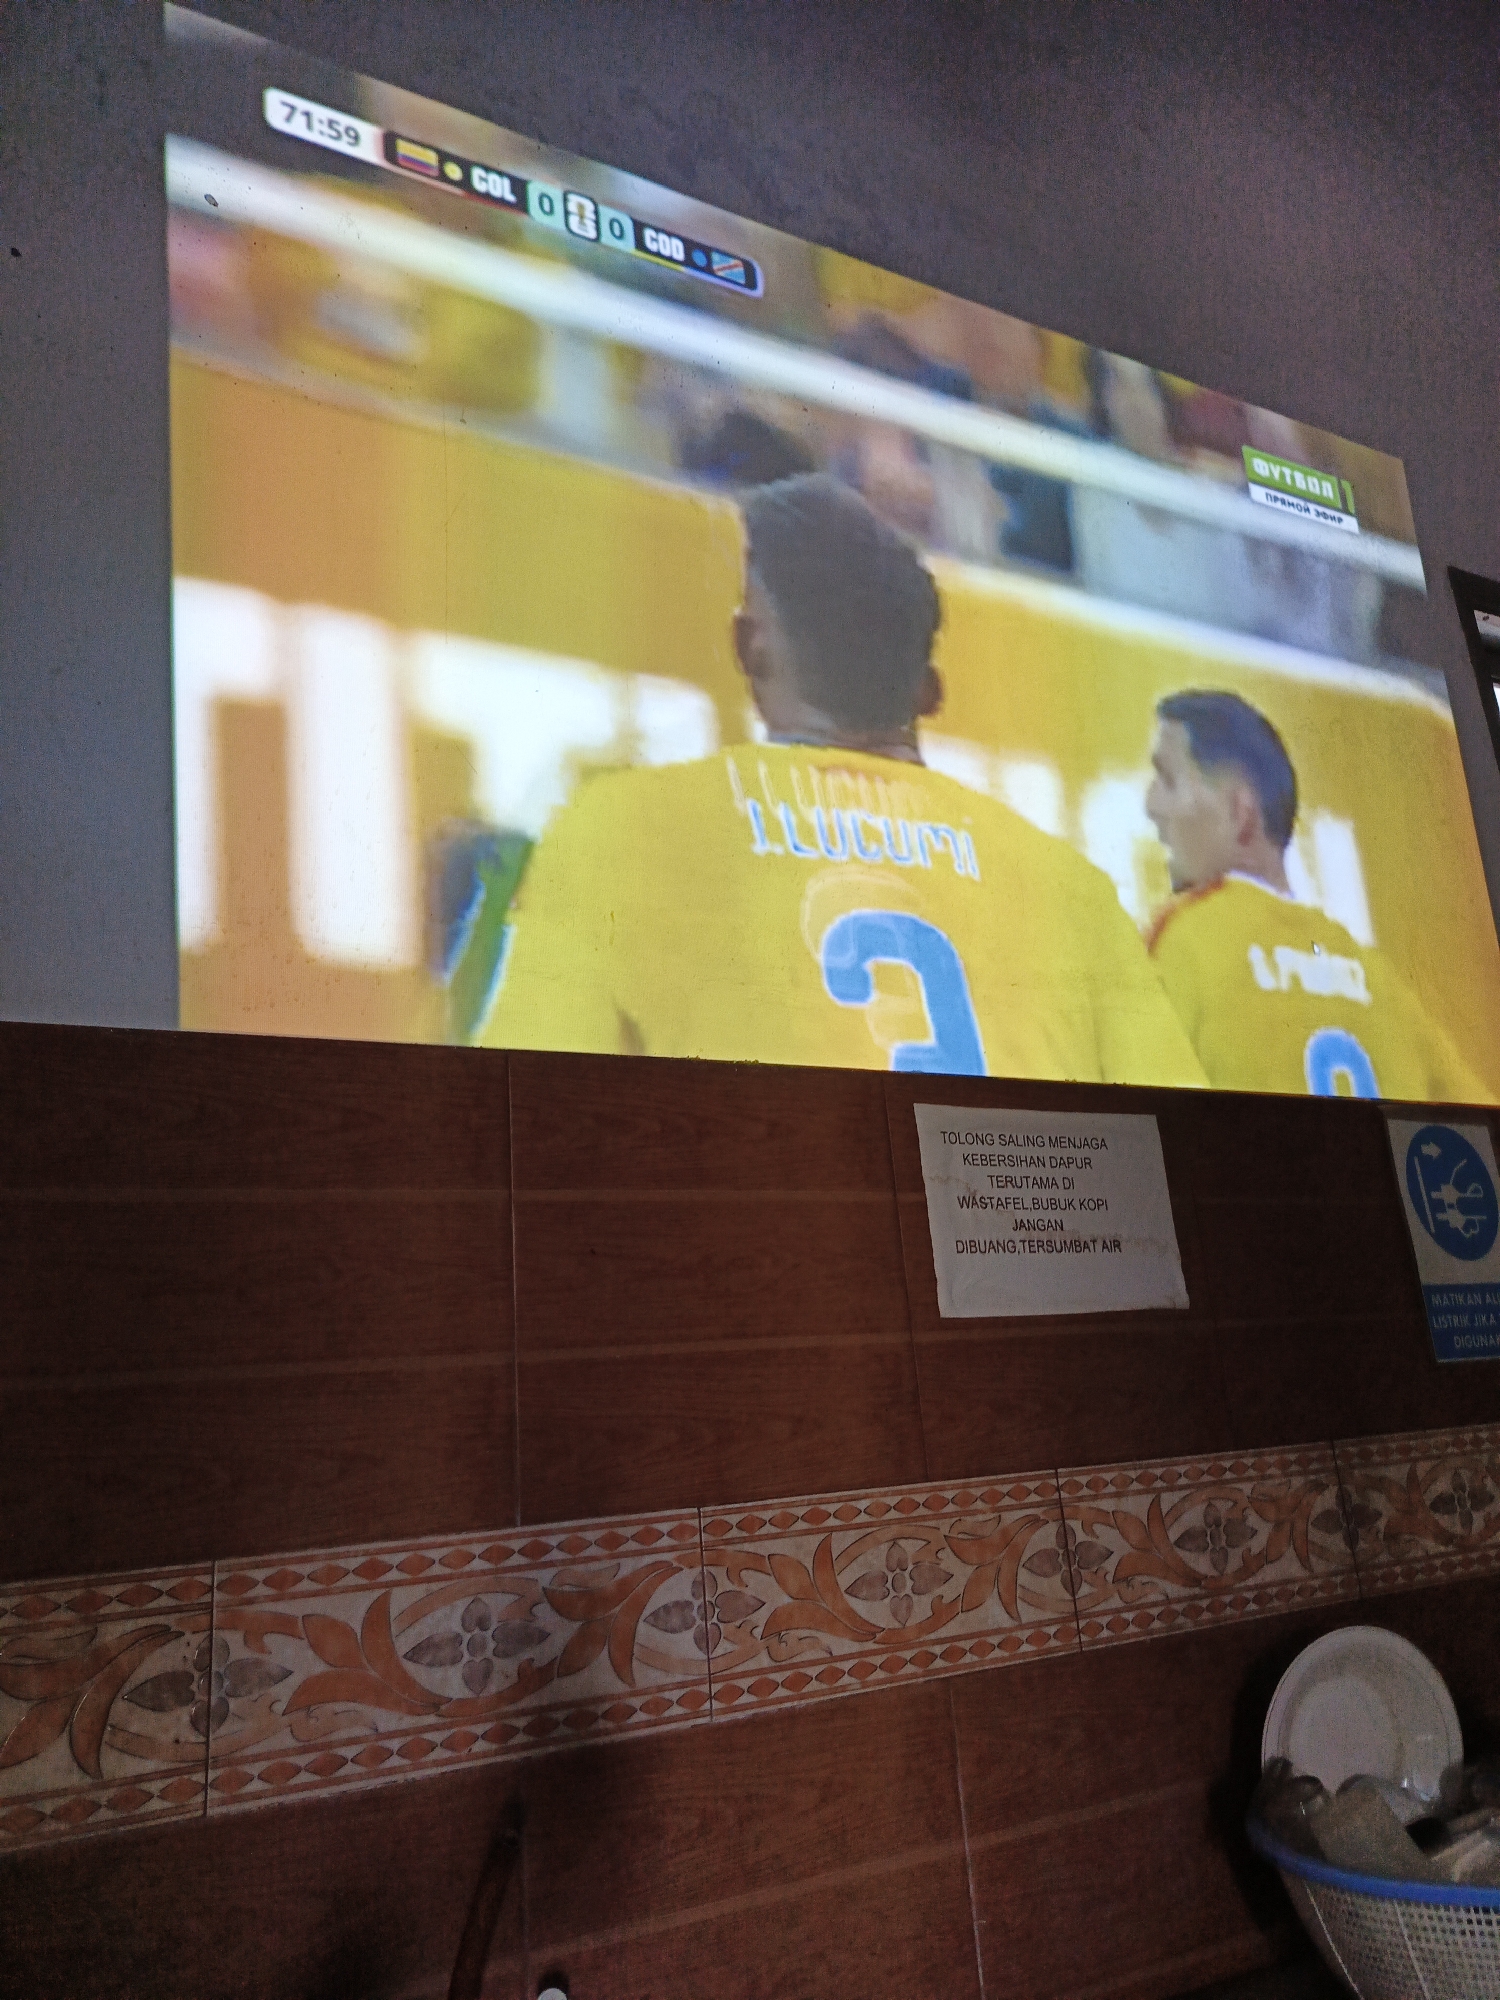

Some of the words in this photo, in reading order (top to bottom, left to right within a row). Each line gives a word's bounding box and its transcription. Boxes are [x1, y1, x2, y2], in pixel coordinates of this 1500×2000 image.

[279, 101, 361, 148] 71:59
[470, 165, 517, 203] COL
[538, 191, 555, 217] 0
[609, 217, 625, 240] 0
[643, 228, 686, 262] COD
[1252, 458, 1334, 500] ФУТБОЛ
[1265, 492, 1311, 515] ПРЯМОЙ
[1314, 509, 1344, 524] ЭФИР
[940, 1131, 995, 1146] TOLONG
[998, 1134, 1045, 1148] SALING
[1049, 1136, 1108, 1150] MENJAGA
[962, 1153, 1046, 1168] KEBERSIHAN
[1049, 1156, 1092, 1170] DAPUR
[987, 1175, 1059, 1190] TERUTAMA
[1062, 1177, 1075, 1190] DI
[957, 1196, 1076, 1212] WASTAFEL,BUBUK
[1079, 1198, 1108, 1211] KOPI
[1012, 1219, 1064, 1232] JANGAN
[956, 1239, 1097, 1255] DIBUANG,TERSUMBAT
[1101, 1239, 1122, 1253] AIR
[1431, 1293, 1482, 1307] MATIKAN
[1432, 1313, 1470, 1328] LISTRIK
[1474, 1313, 1497, 1327] JIKA
